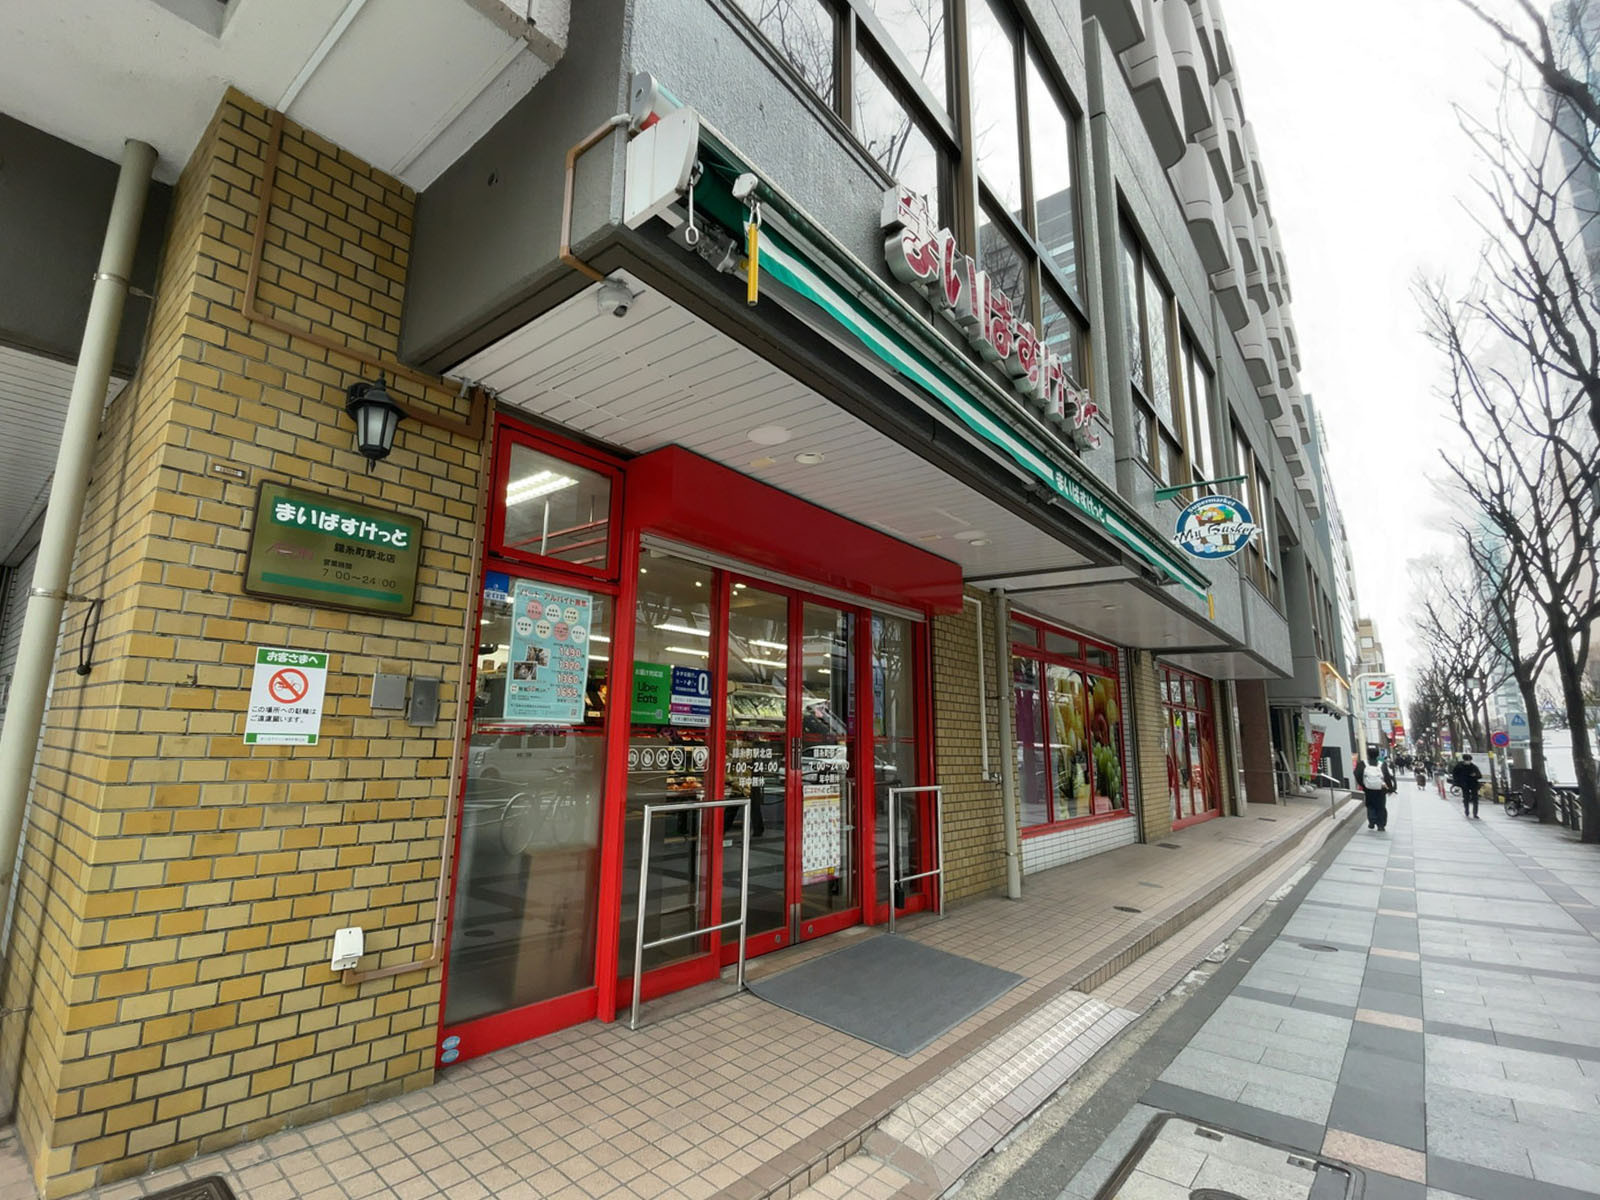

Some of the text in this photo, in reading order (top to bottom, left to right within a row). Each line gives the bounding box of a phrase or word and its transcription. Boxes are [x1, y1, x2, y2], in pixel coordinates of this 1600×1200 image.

[881, 184, 1101, 450] まいばすけっと
[1055, 471, 1105, 523] まいばすけっと
[1187, 496, 1236, 513] Supermarket
[275, 502, 408, 547] まいばすけっと
[1174, 522, 1255, 543] My Basket
[266, 651, 319, 664] お客さまへ
[637, 681, 658, 693] Uber
[637, 693, 658, 704] Eats
[251, 705, 317, 715] この場所への駐輪は
